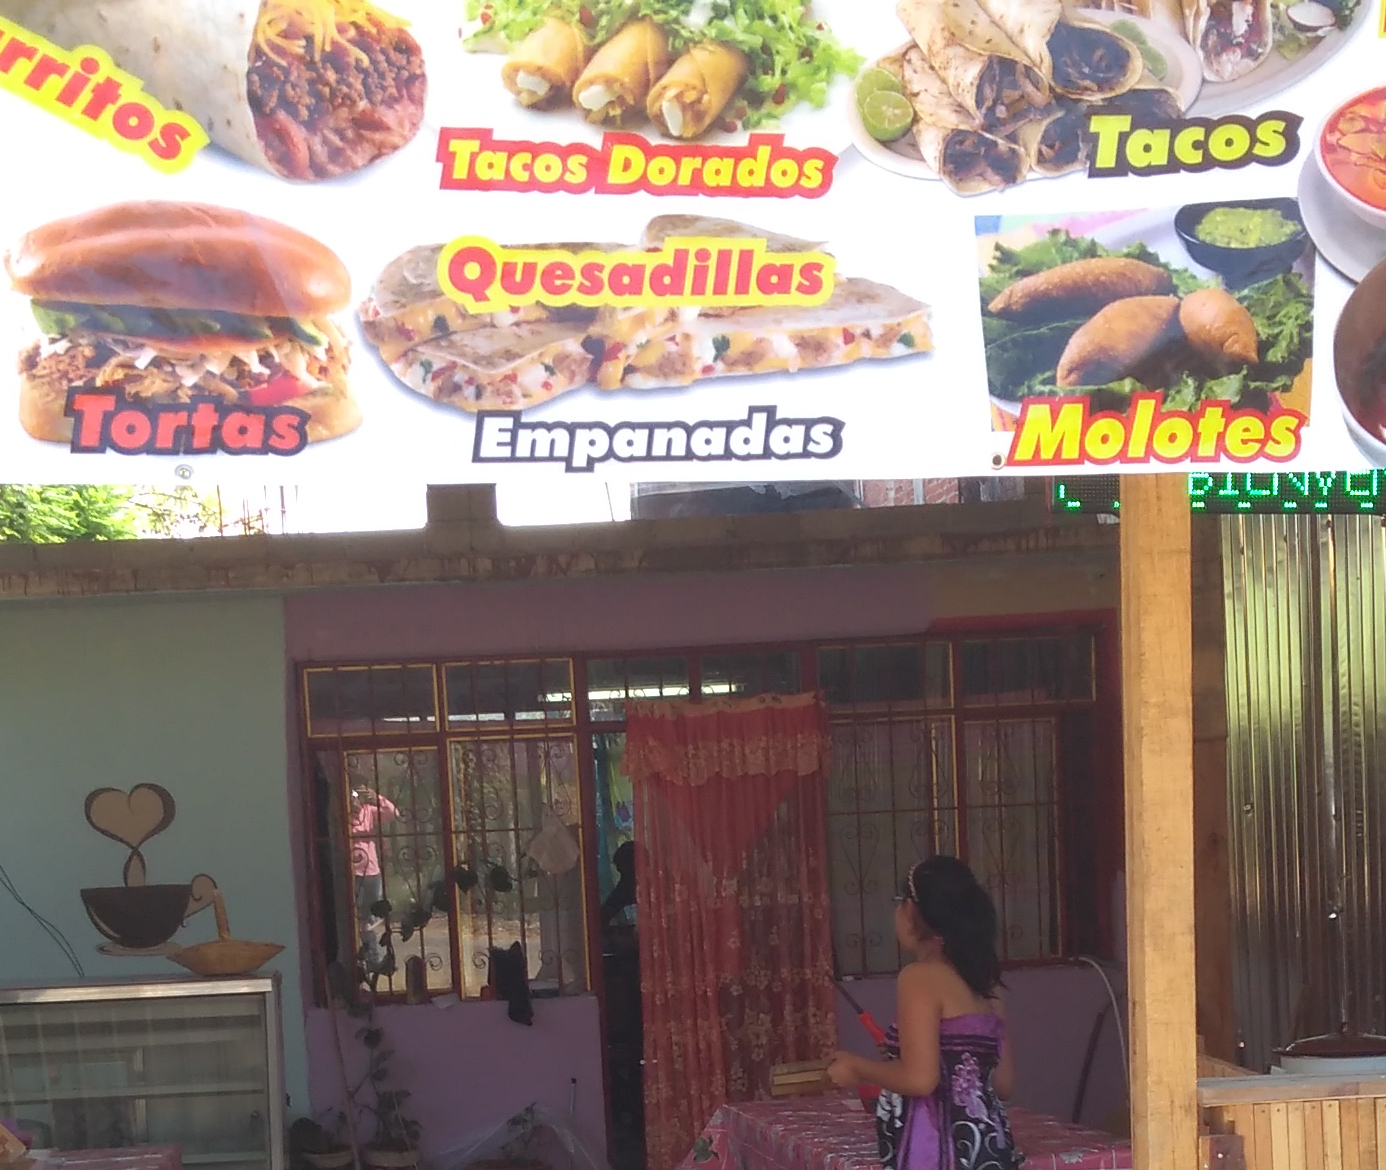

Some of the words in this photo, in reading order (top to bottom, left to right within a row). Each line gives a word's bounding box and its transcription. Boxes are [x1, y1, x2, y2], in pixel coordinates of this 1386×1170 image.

[448, 139, 588, 184] Tacos
[608, 144, 824, 189] Dorados
[1090, 114, 1287, 168] Tacos
[447, 245, 824, 303] Quesadillas
[73, 394, 304, 454] Tortas
[479, 413, 835, 467] Empanadas
[1014, 398, 1300, 462] Molotes
